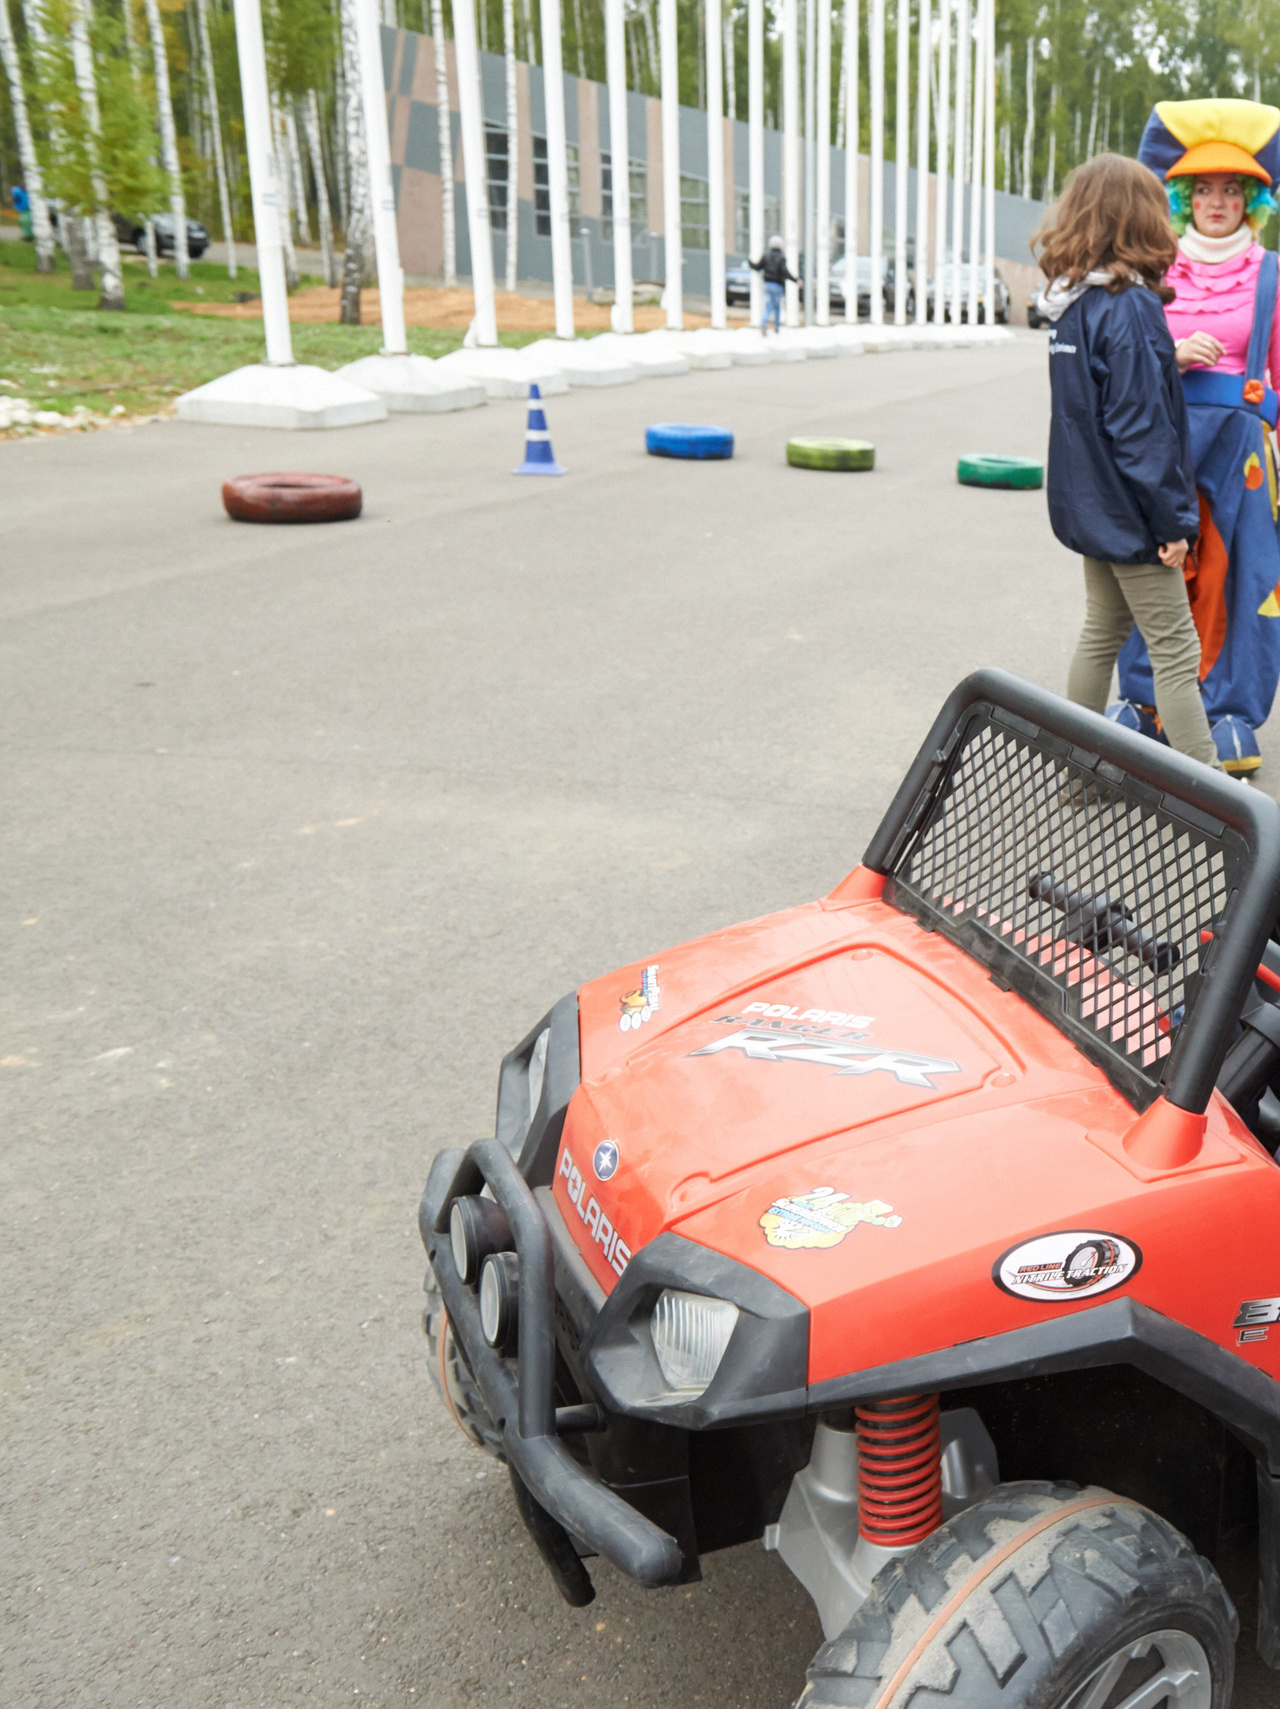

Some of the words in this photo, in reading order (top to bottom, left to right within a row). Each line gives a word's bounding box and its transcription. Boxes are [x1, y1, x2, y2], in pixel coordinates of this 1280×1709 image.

[709, 1014, 874, 1041] RANGER
[741, 1001, 876, 1029] POLARIS
[681, 1028, 963, 1090] RZR
[559, 1147, 632, 1277] POLARIS
[1011, 1271, 1064, 1285] NITRILE
[1066, 1263, 1128, 1279] TRACTION
